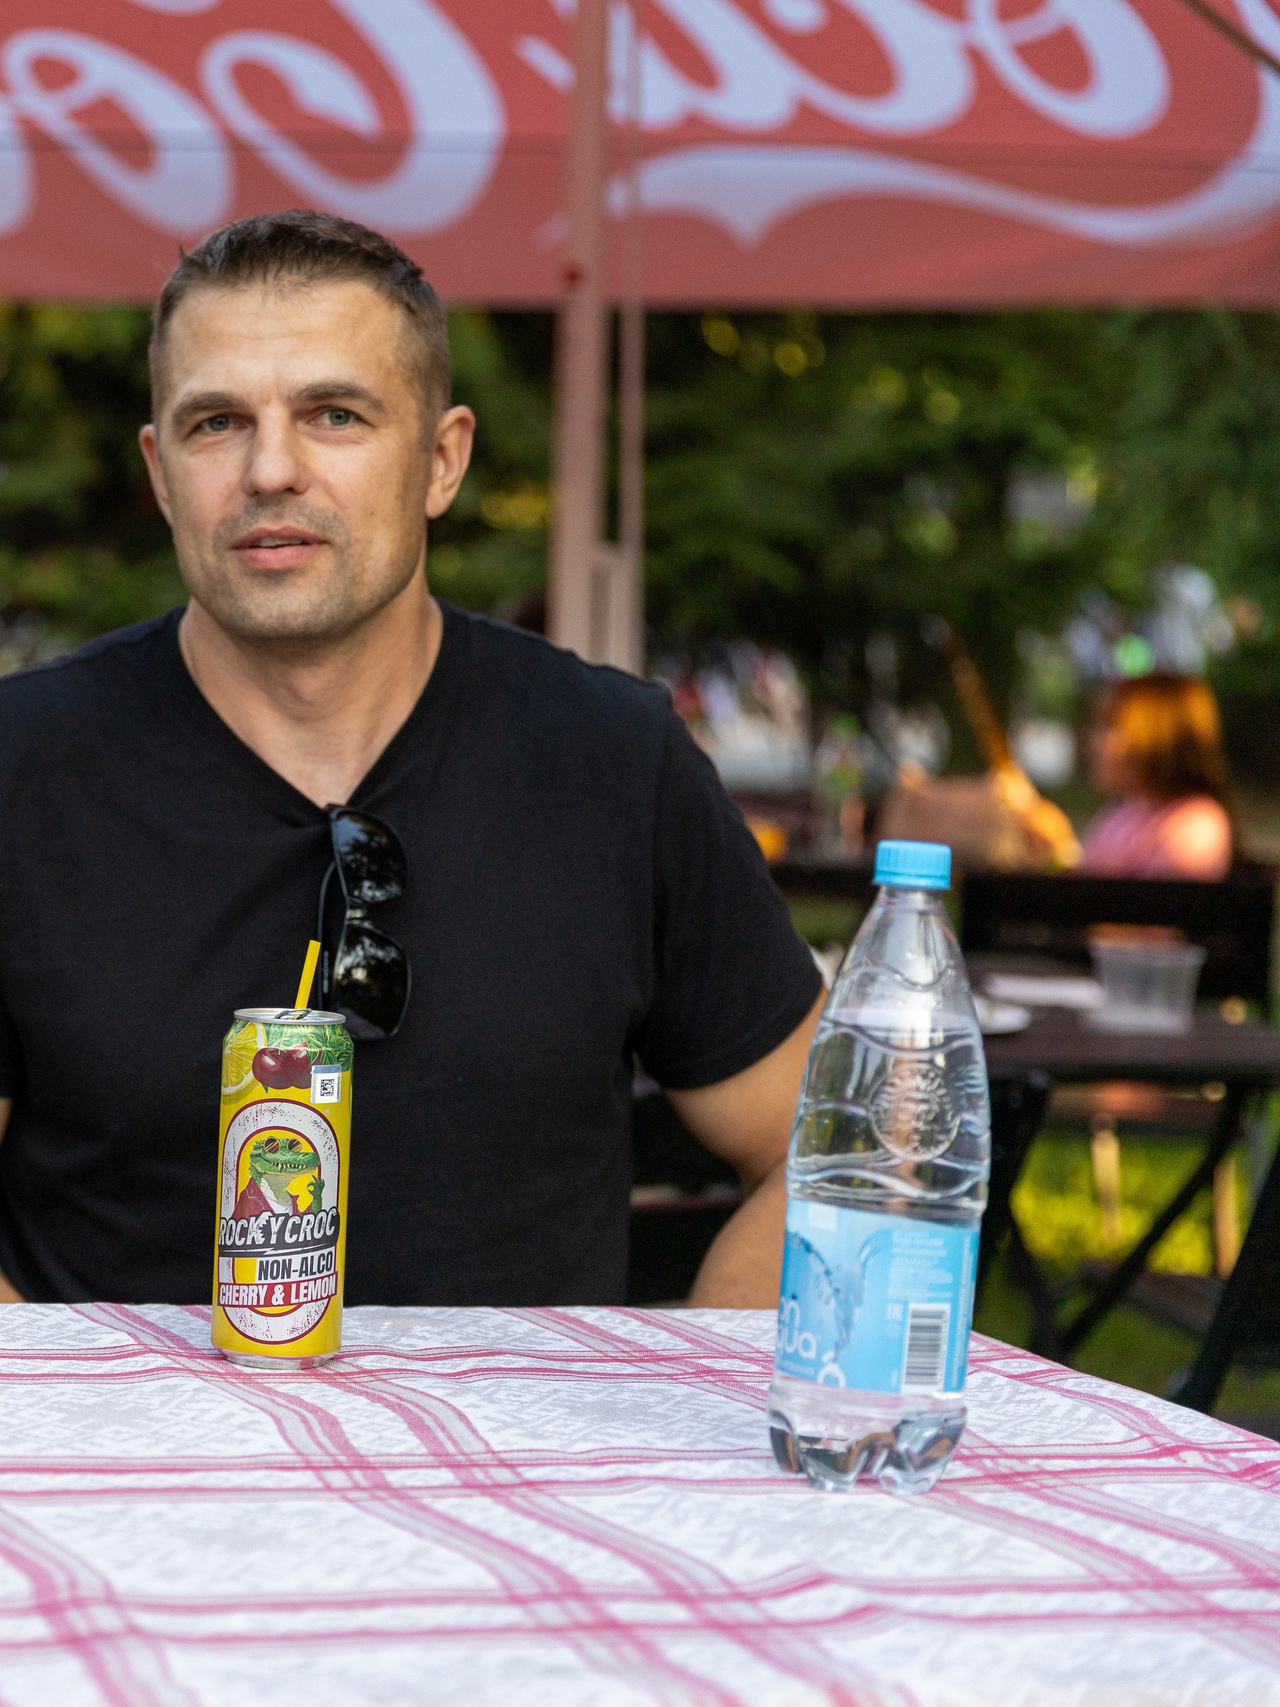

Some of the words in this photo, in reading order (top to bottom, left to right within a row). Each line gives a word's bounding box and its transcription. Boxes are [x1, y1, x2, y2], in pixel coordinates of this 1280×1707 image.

[258, 1251, 333, 1281] NON-ALCO
[220, 1284, 268, 1306] CHERRY
[271, 1284, 286, 1306] &
[290, 1275, 337, 1304] LEMON
